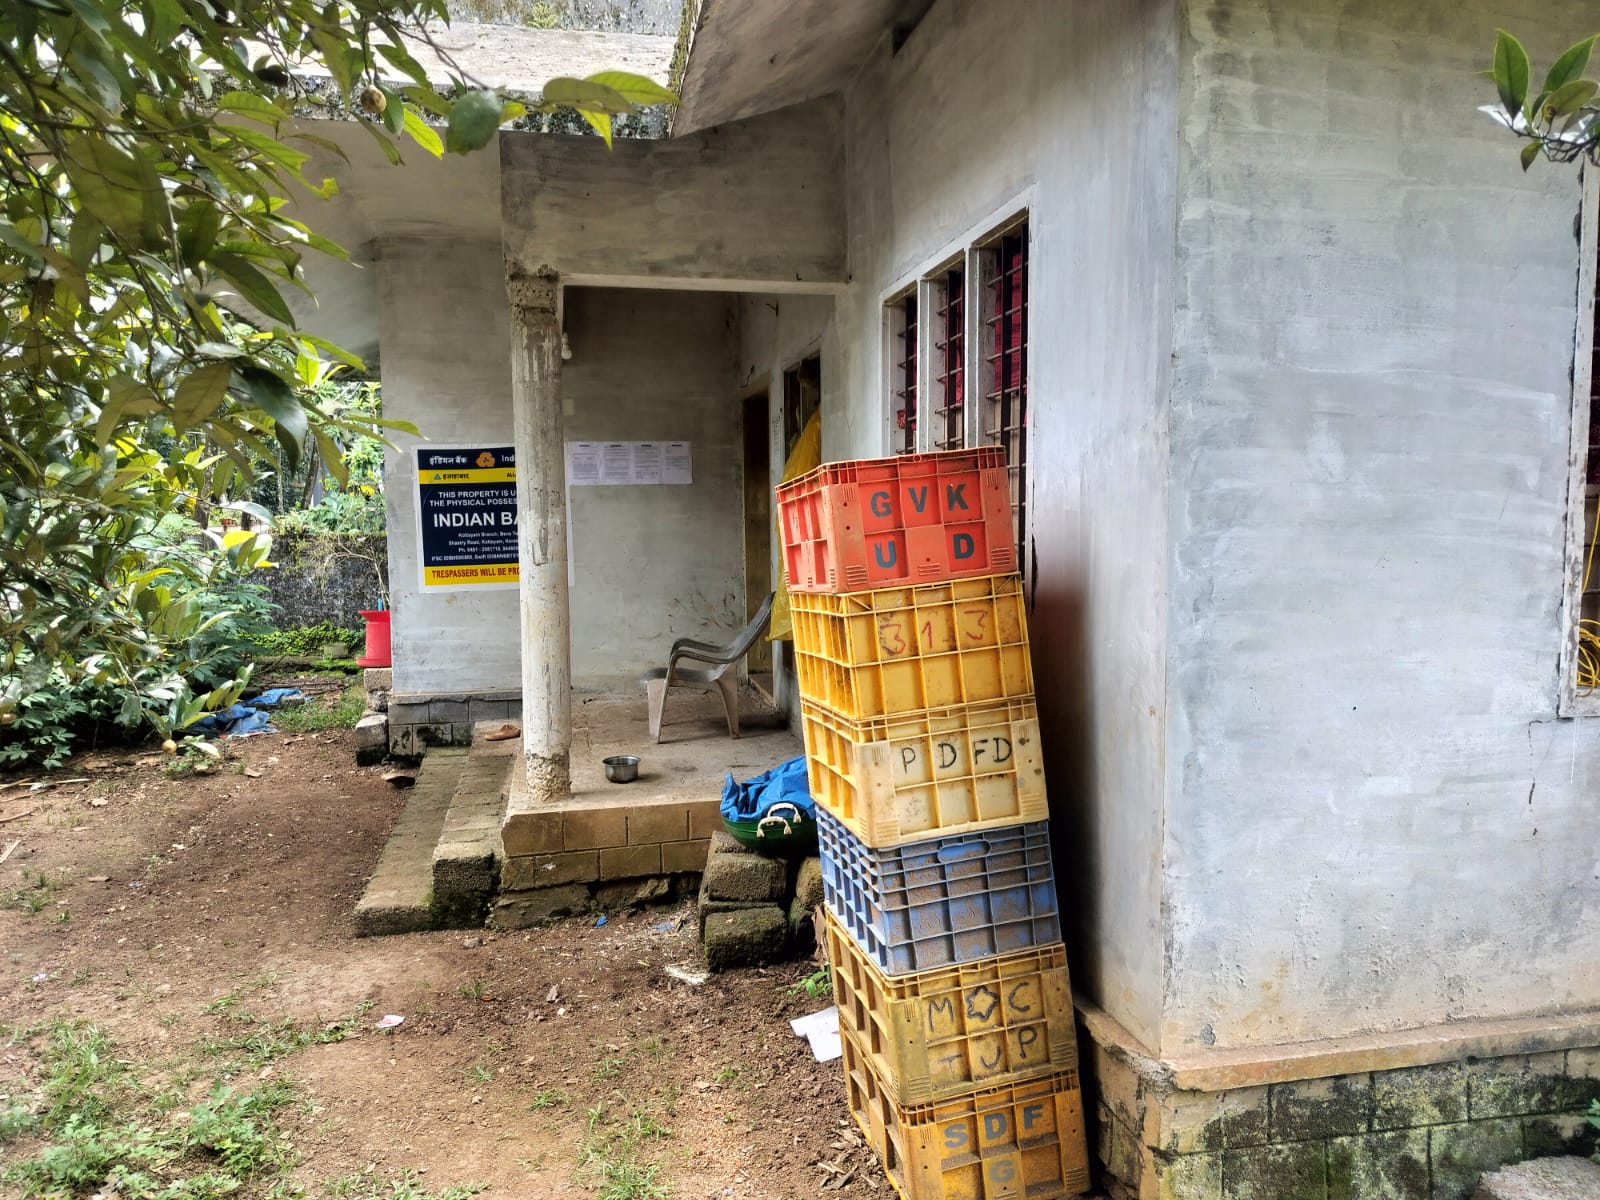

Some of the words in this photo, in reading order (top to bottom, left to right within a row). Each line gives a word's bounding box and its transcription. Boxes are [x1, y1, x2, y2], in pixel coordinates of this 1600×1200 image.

[458, 490, 500, 498] PROPERTY
[501, 489, 509, 497] IS
[446, 499, 486, 507] PHYSICAL
[433, 512, 495, 527] INDIAN
[432, 568, 479, 579] TRESPASSERS
[480, 567, 496, 577] WILL
[497, 567, 507, 576] BE
